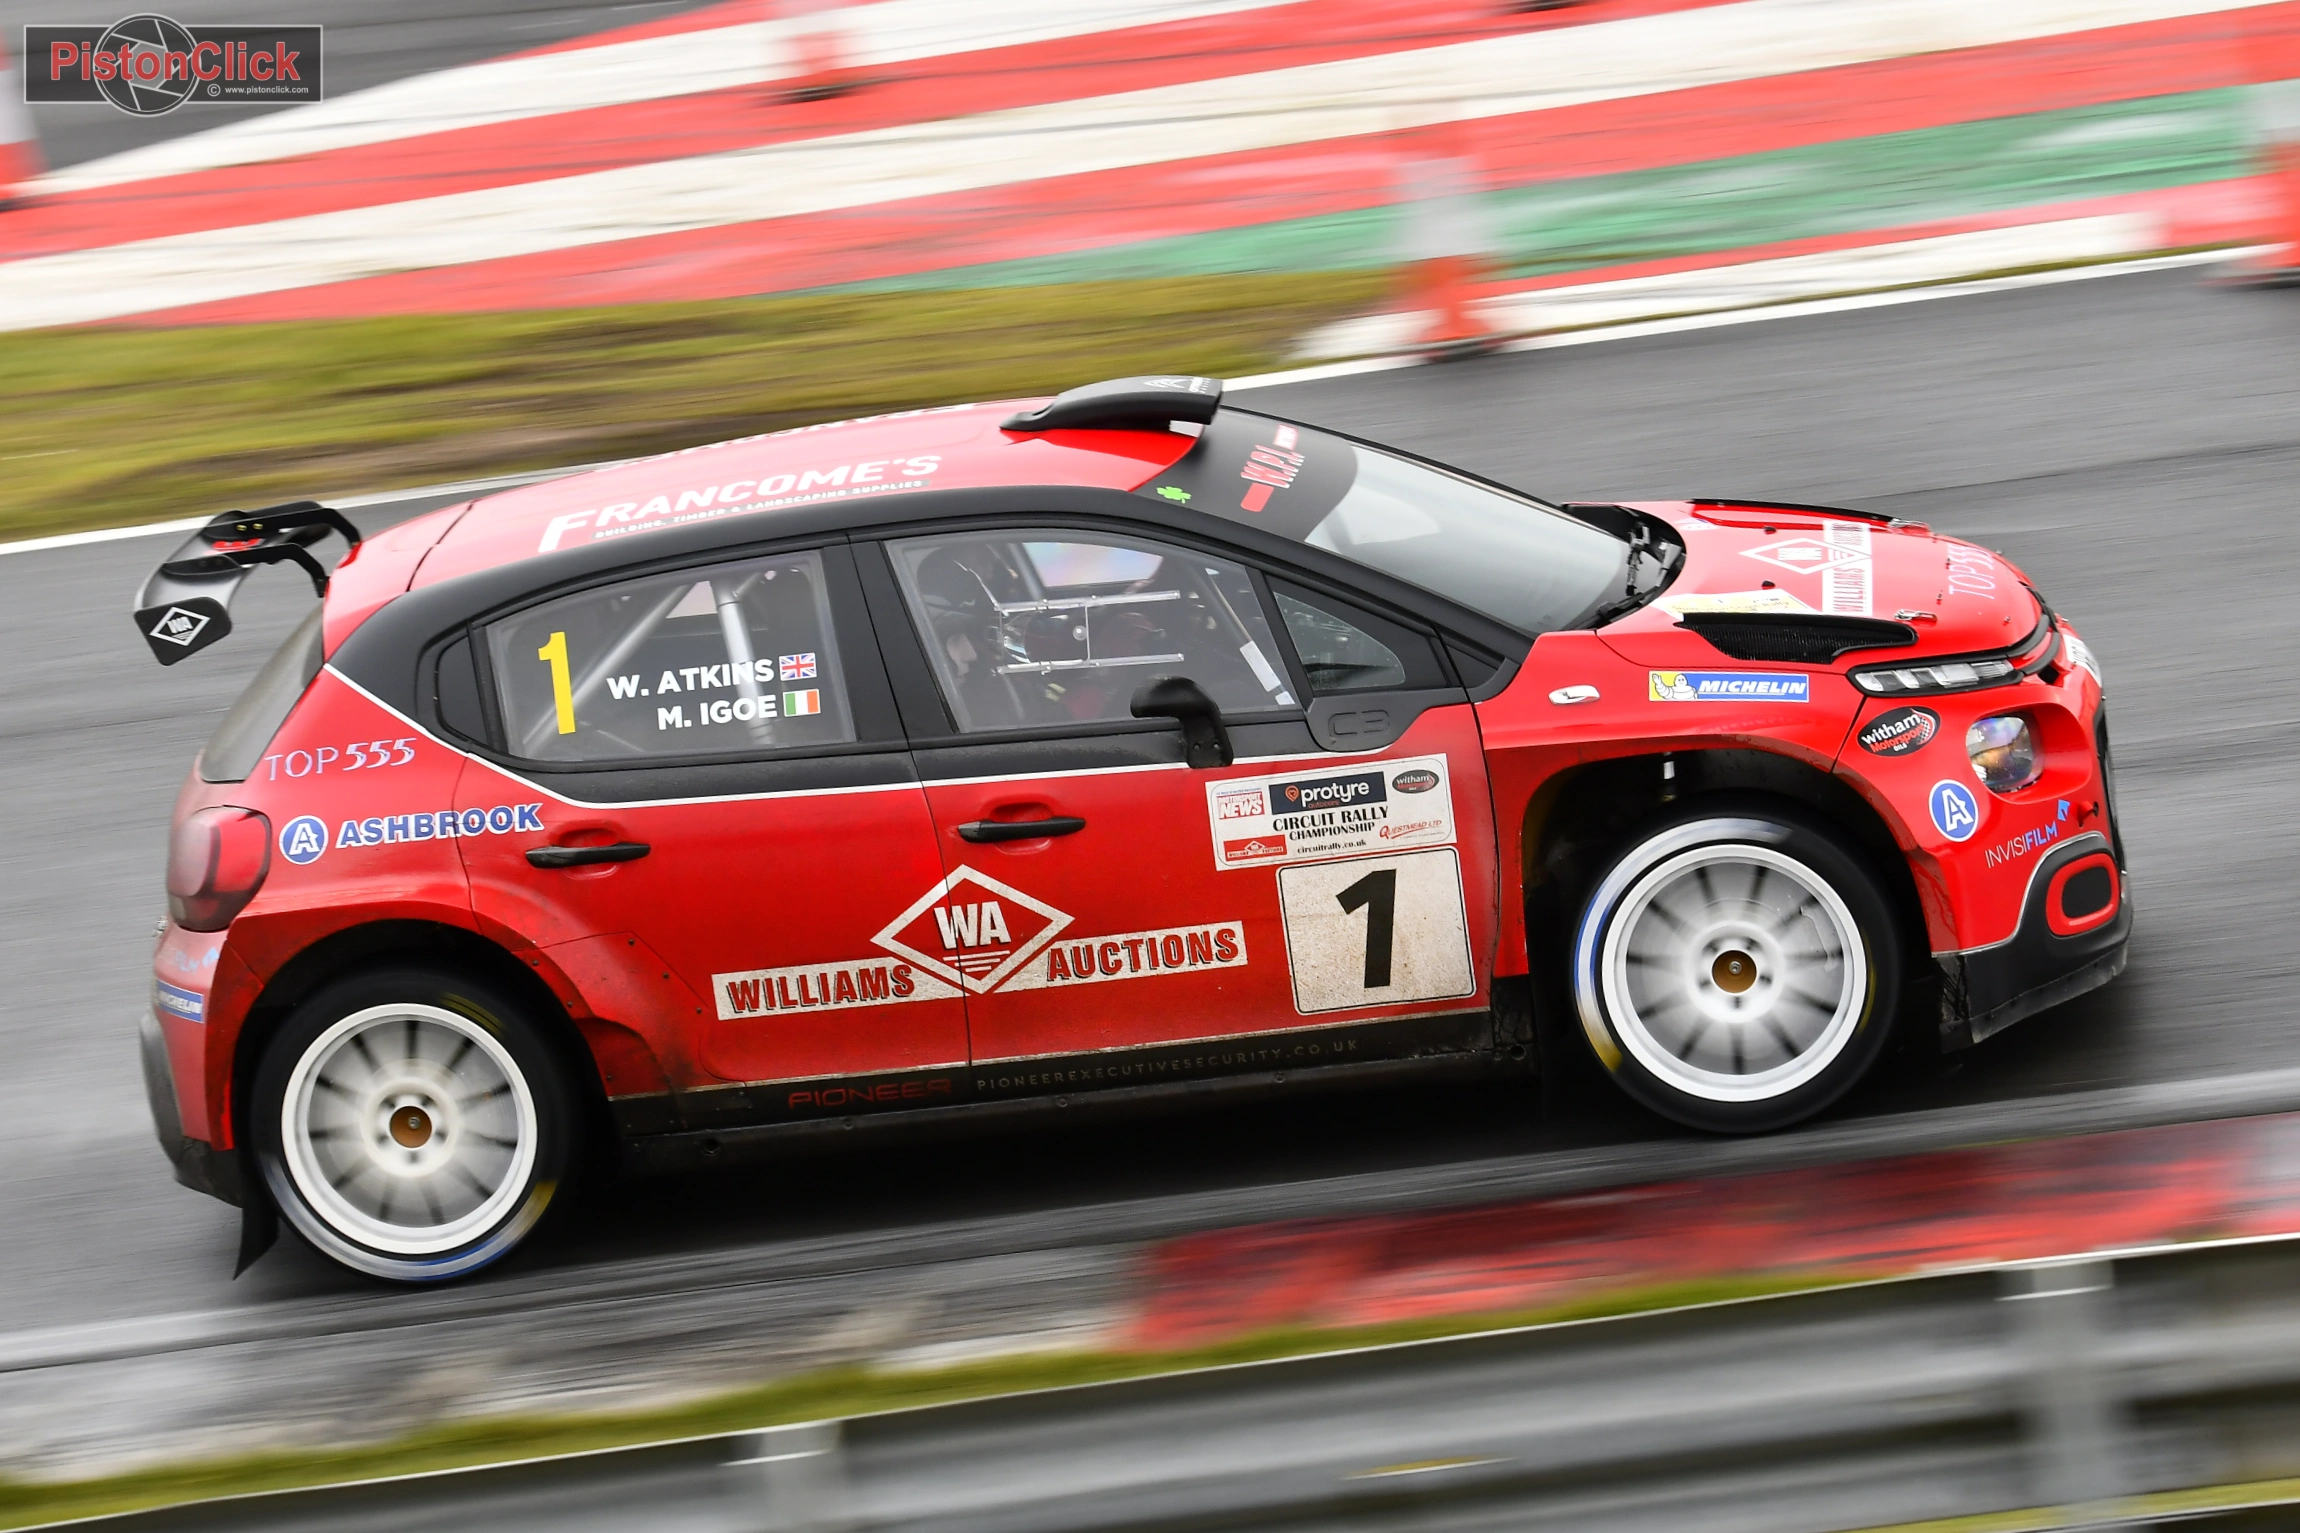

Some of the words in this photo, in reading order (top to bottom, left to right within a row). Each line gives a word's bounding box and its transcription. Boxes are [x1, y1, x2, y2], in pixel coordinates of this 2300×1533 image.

[537, 455, 942, 553] FRANCOME'S
[672, 508, 726, 523] TIMBER
[746, 490, 847, 510] LANDSCAPING
[852, 480, 923, 494] SUPPLIES
[1832, 567, 1866, 613] WILLIAMS
[538, 631, 576, 735] 1
[606, 674, 649, 700] W.
[657, 659, 775, 695] ATKINS
[1698, 679, 1806, 697] MICHELIN
[657, 706, 692, 731] M.
[700, 694, 778, 726] IGOE
[1861, 714, 1921, 745] witham
[264, 746, 340, 781] TOP
[342, 737, 417, 772] 555
[1396, 775, 1430, 784] witham
[1219, 800, 1263, 818] NEWS
[1300, 782, 1370, 808] protyre
[335, 802, 545, 848] ASHBROOK
[1272, 812, 1336, 832] CIRCUIT
[1341, 805, 1389, 824] RALLY
[1289, 821, 1375, 841] CHAMPIONSHIP
[1297, 839, 1367, 854] circuitrally.co.uk
[1984, 821, 2057, 868] INVISIFILM
[932, 900, 1012, 950] WA
[1335, 868, 1397, 989] 1
[1046, 928, 1241, 982] AUCTIONS
[727, 964, 916, 1014] WILLIAMS
[787, 1078, 952, 1109] PIONEER
[976, 1039, 1359, 1091] PIONEEREXECUTIVESECURITY.CO.UK
